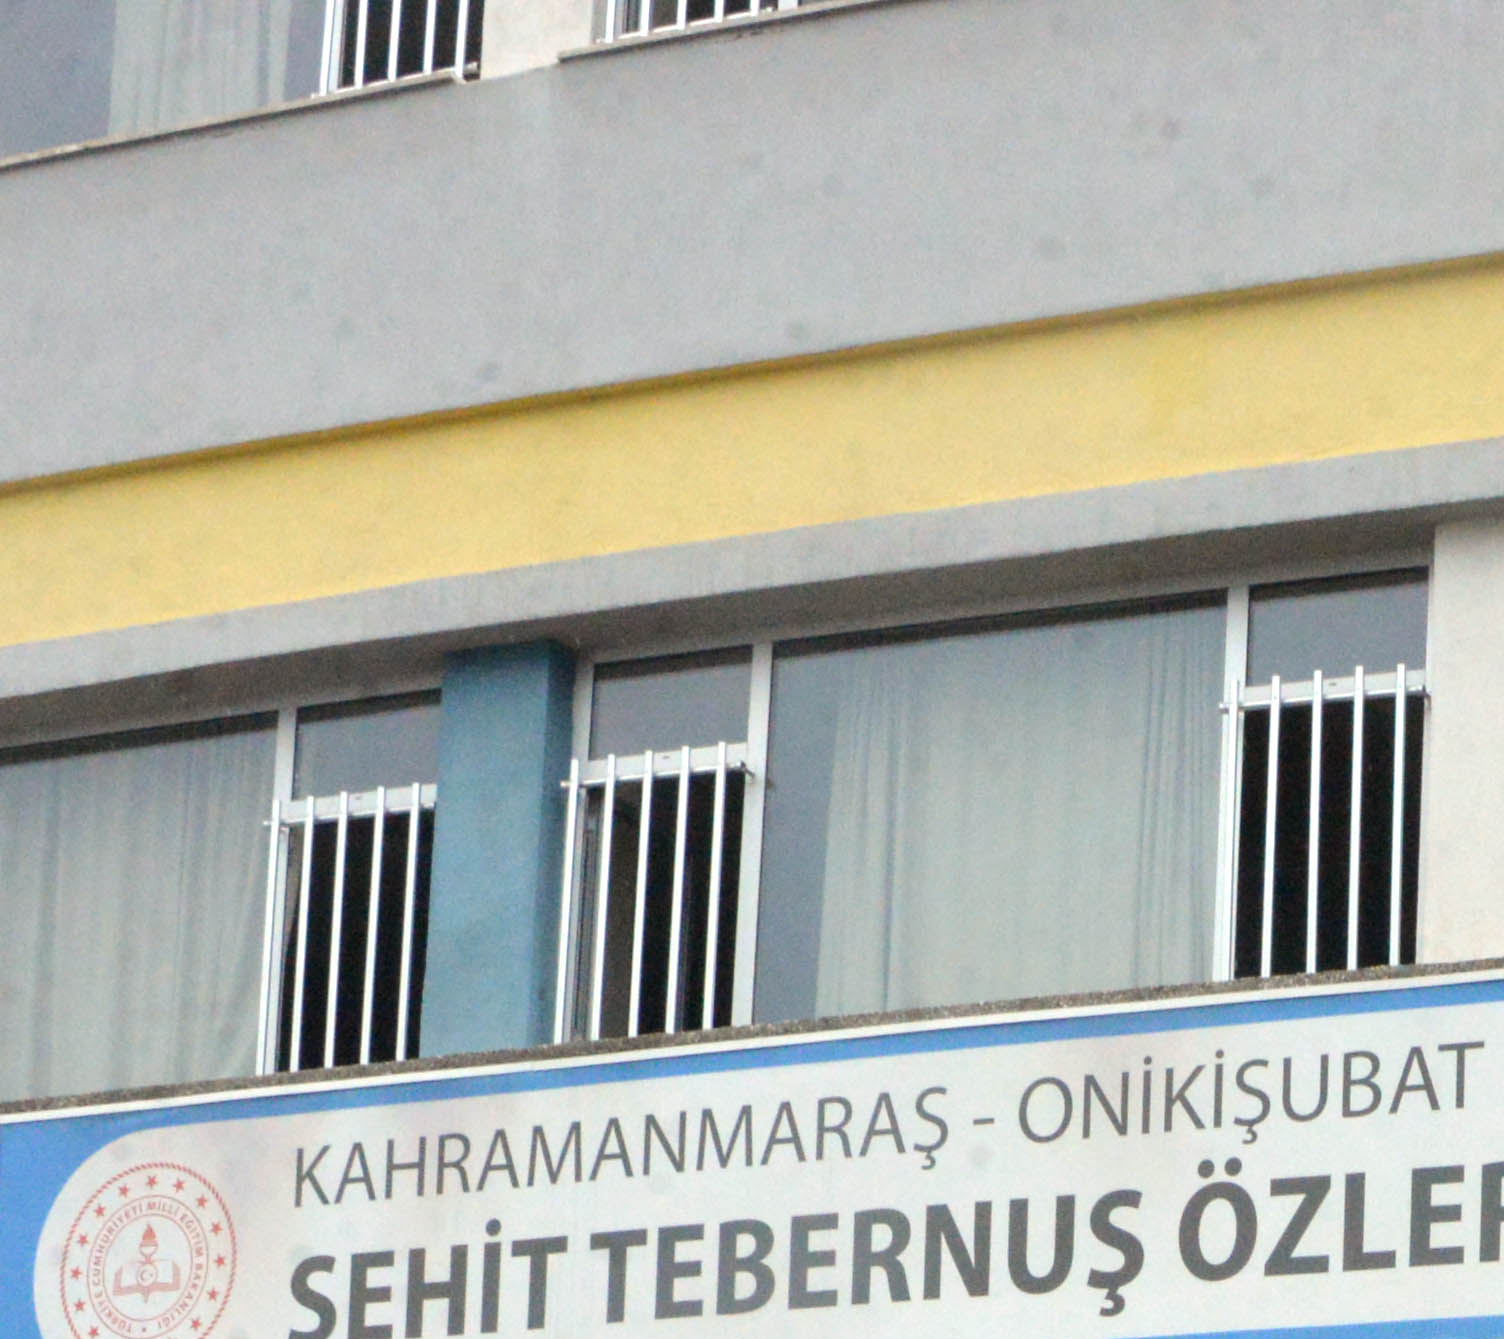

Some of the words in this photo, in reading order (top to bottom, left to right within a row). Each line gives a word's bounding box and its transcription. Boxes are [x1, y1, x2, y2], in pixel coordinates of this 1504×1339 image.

[295, 1087, 948, 1207] KAHRAMANMARAŞ
[1018, 1041, 1485, 1144] ONİKİŞUBAT
[590, 1189, 1145, 1317] TEBERNUŞ
